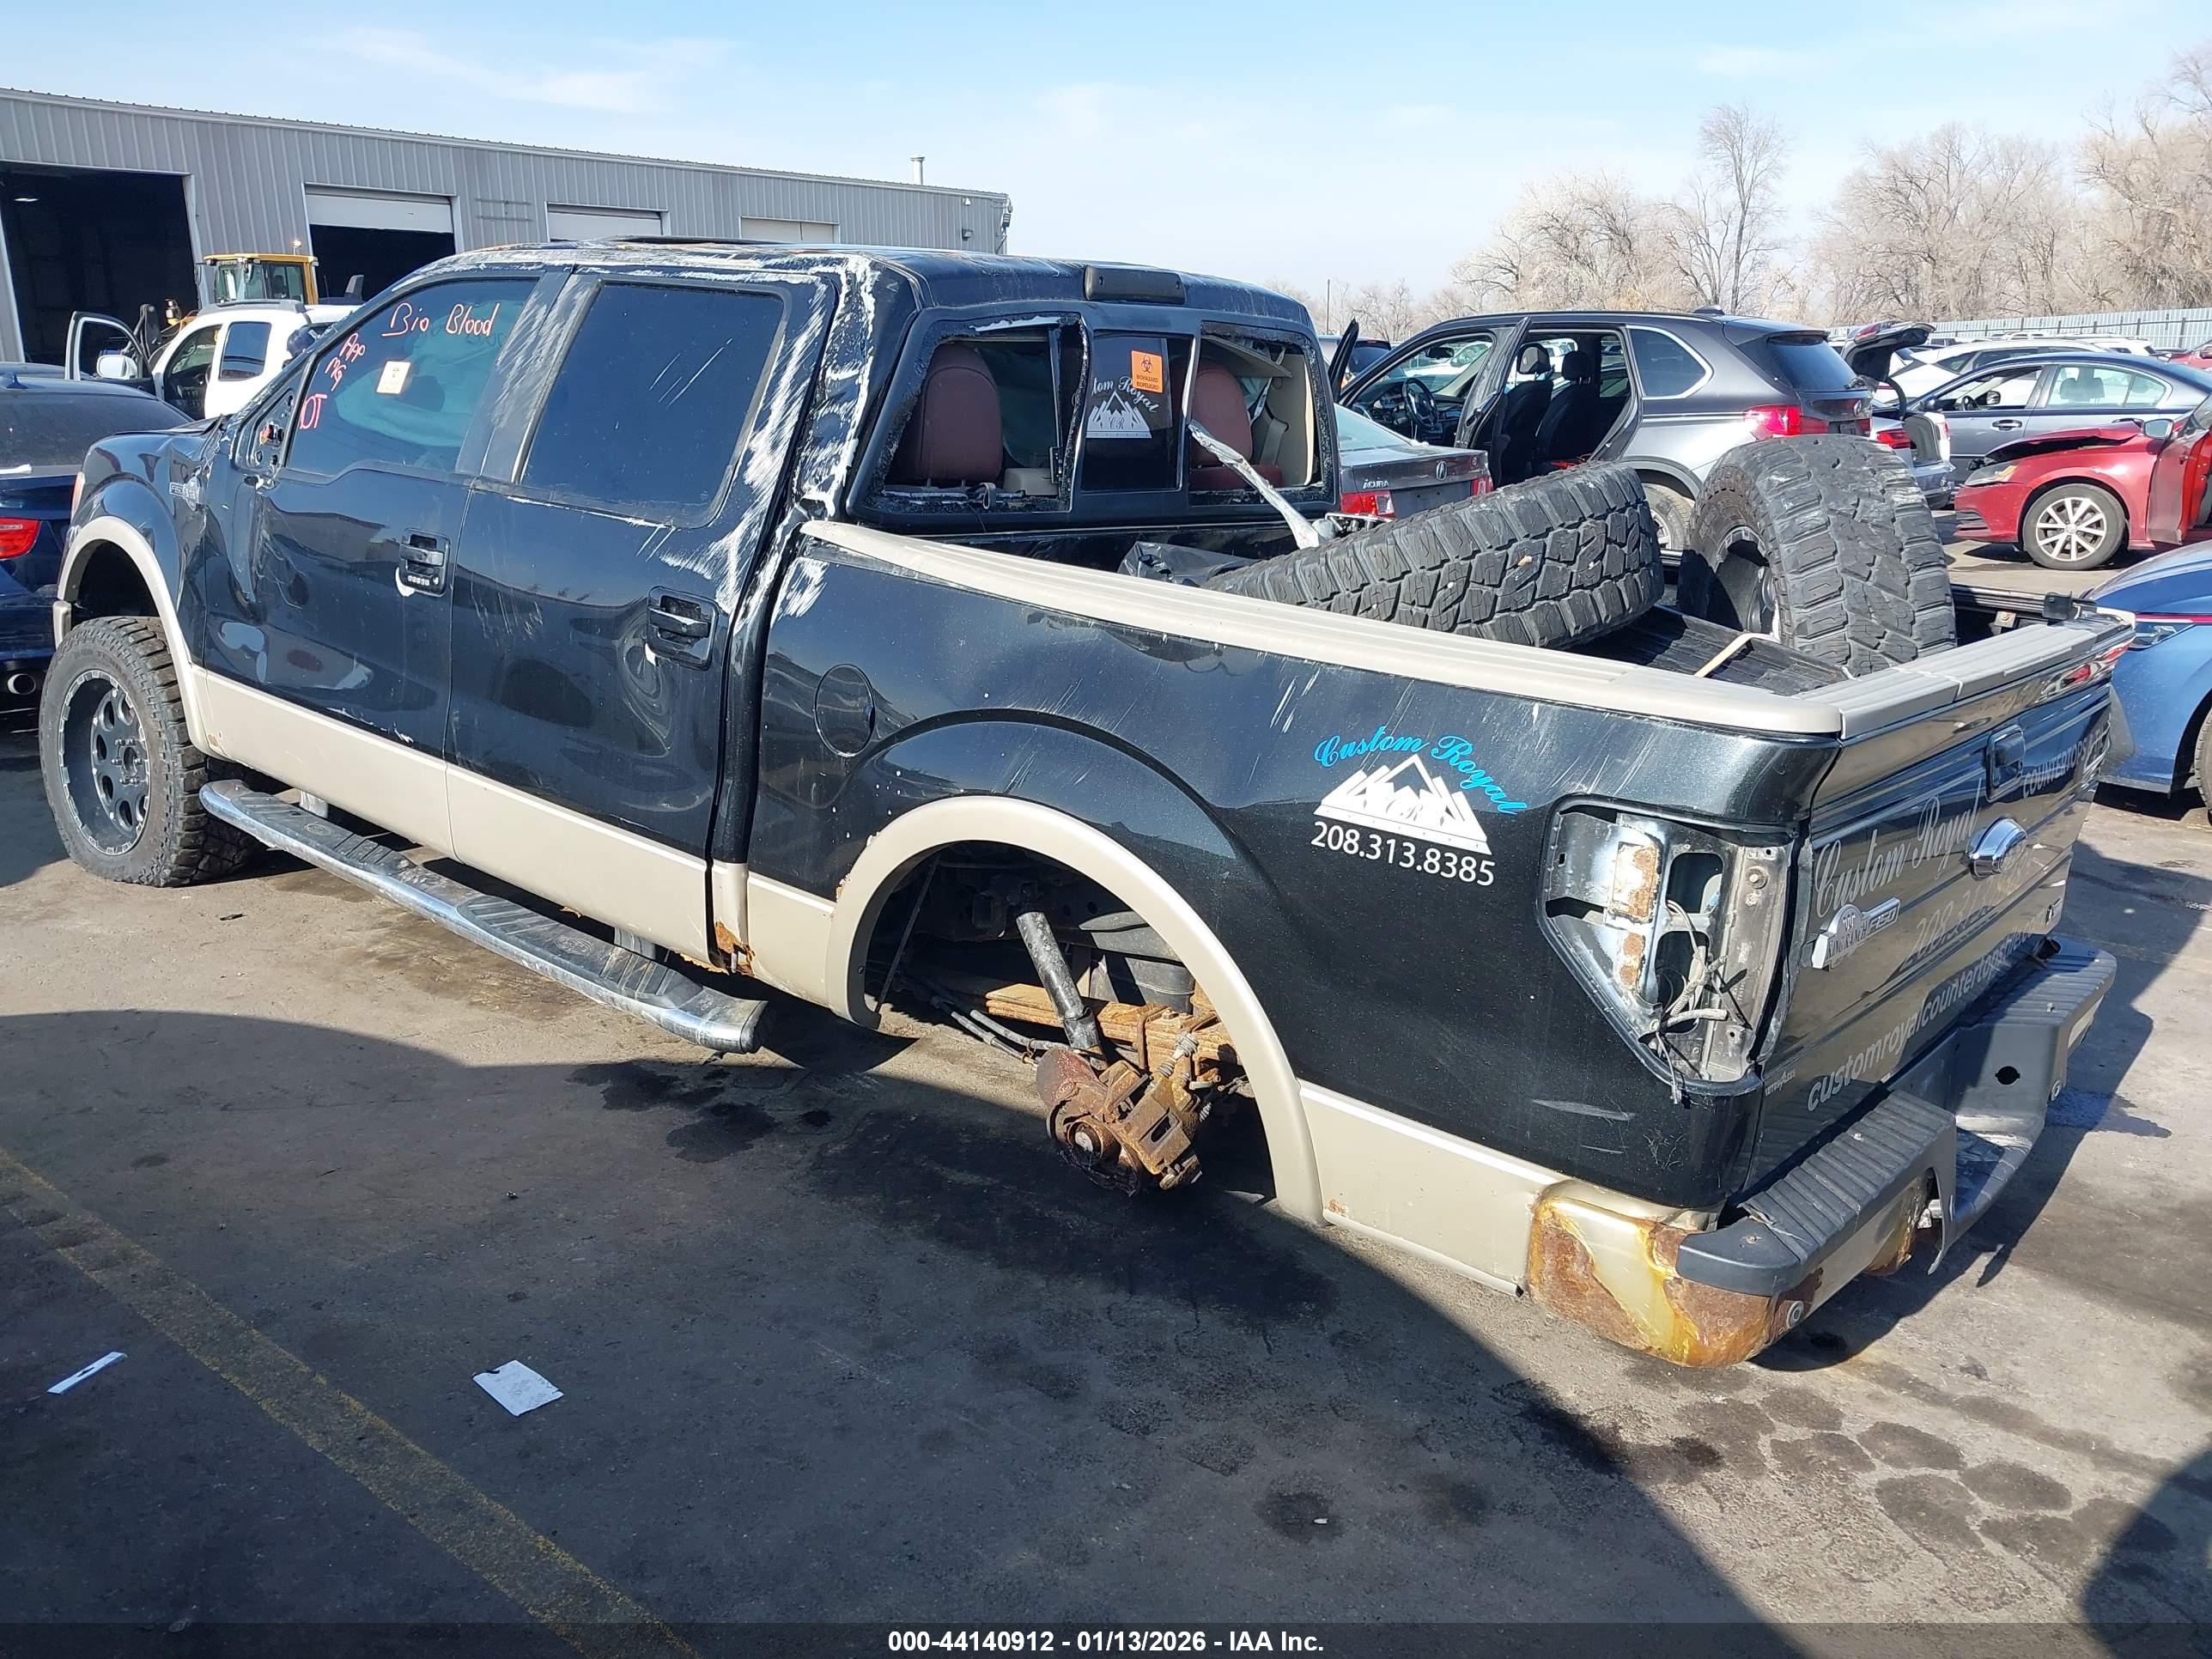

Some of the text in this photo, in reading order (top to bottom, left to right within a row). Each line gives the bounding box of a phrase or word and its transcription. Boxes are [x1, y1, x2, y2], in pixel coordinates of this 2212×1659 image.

[382, 302, 500, 337] Bio Blood
[1091, 377, 1114, 396] tom
[1363, 479, 1389, 489] ACURA
[1315, 726, 1528, 815] Custom Royal
[2022, 737, 2087, 799] COUNTERTOPS
[1310, 820, 1496, 886] 208.313.8385
[1814, 777, 1982, 918] Custom Royal
